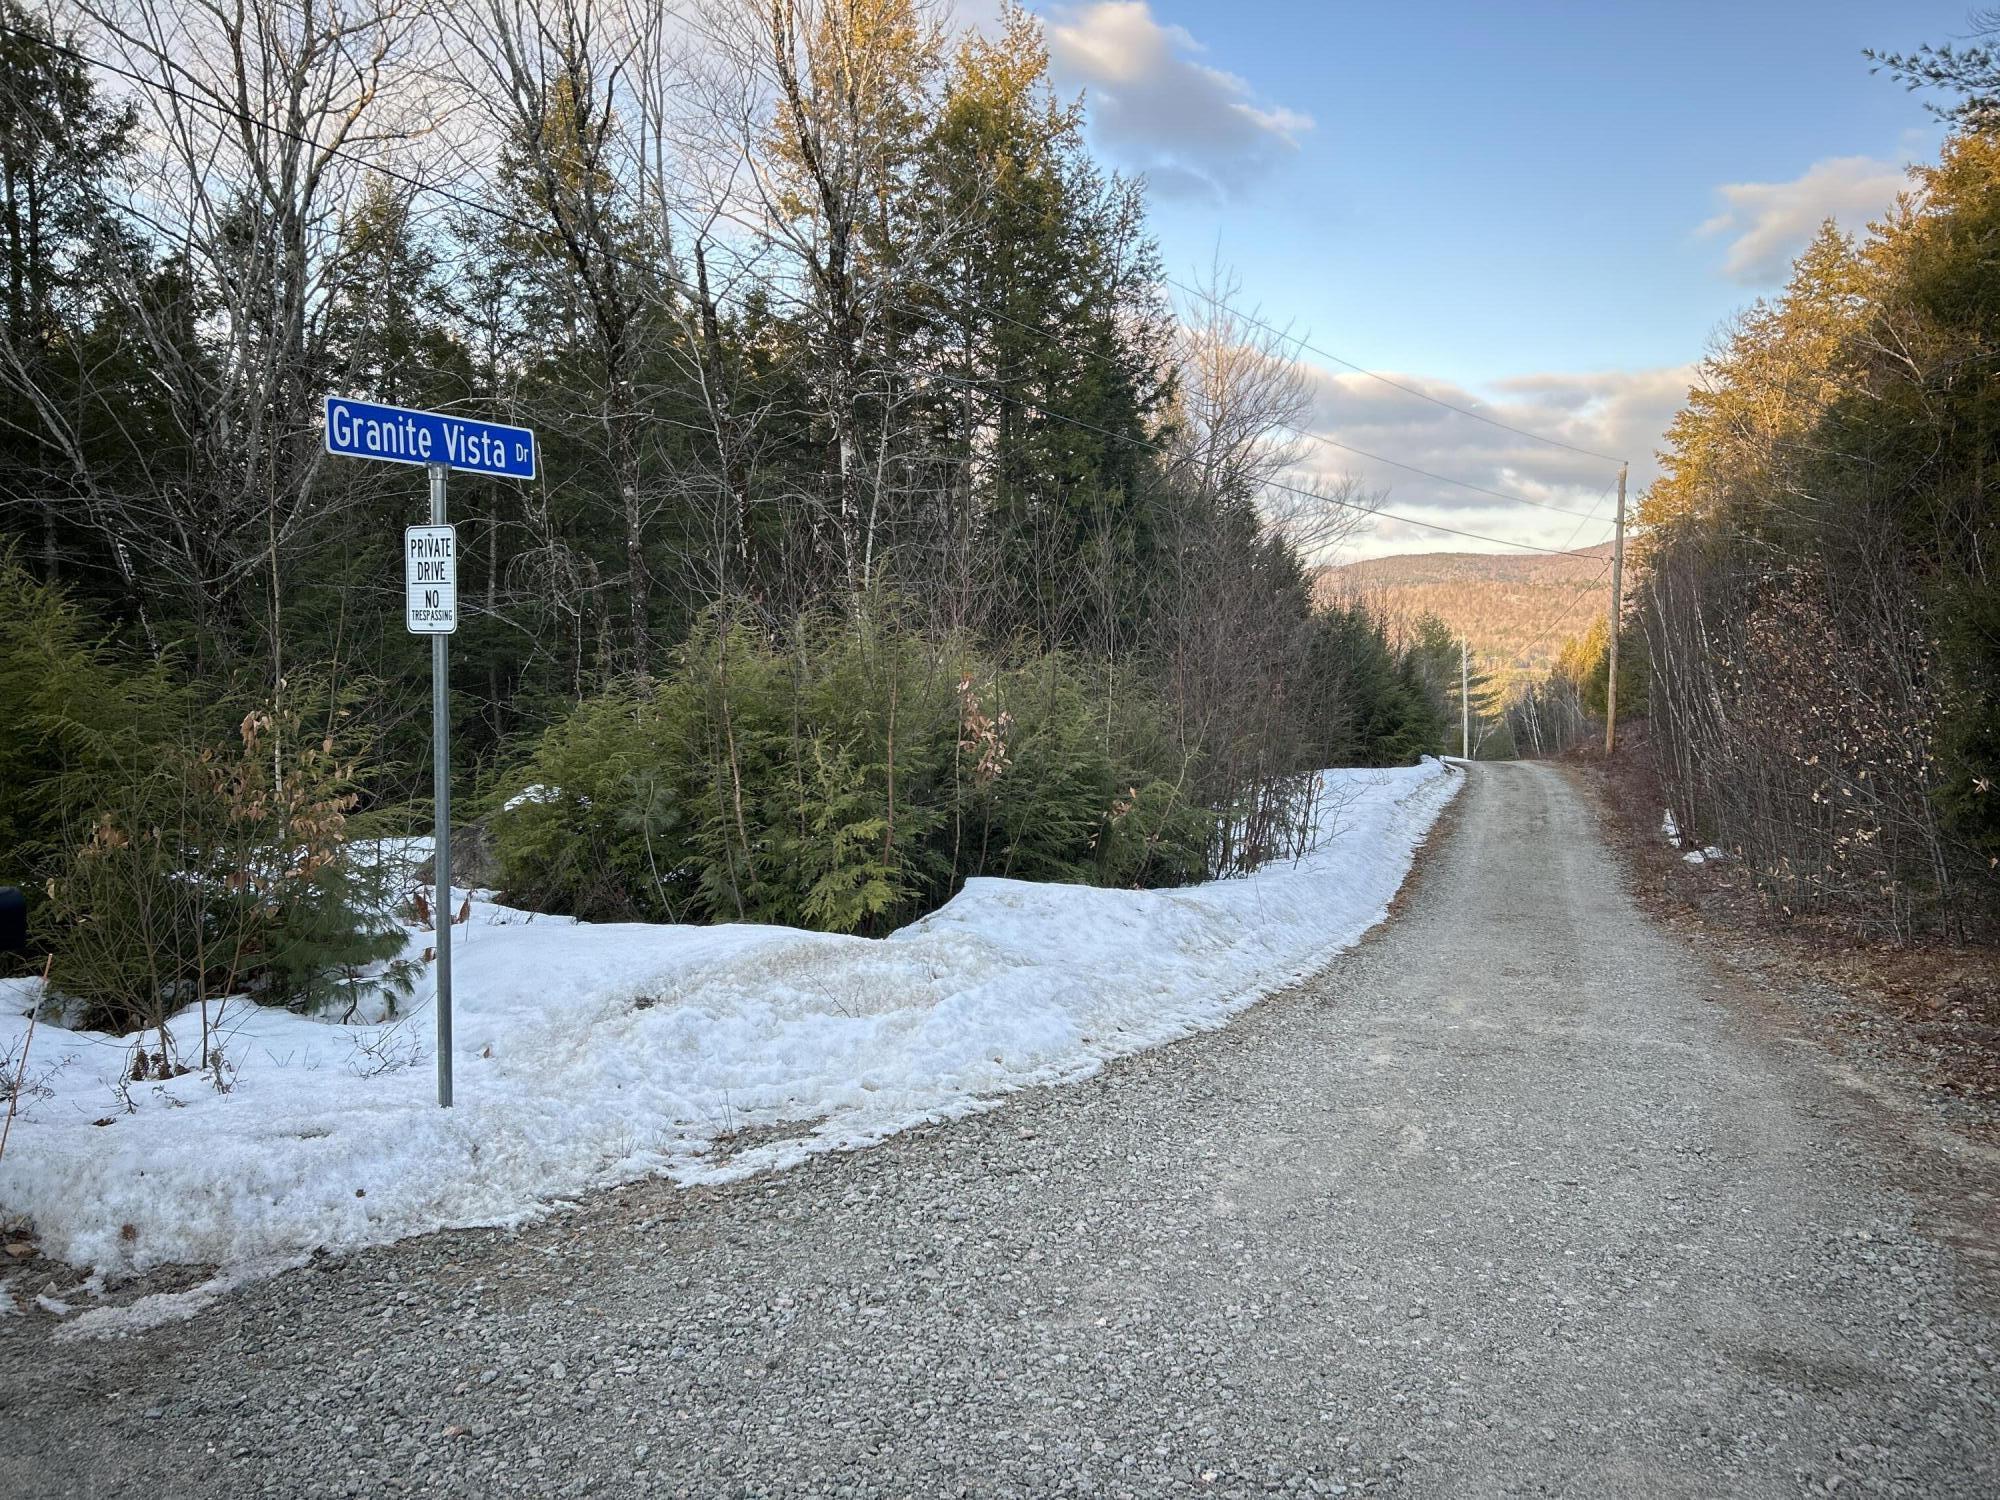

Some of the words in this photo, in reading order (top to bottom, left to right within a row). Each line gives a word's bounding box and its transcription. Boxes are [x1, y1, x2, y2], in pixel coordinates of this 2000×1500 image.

[332, 405, 432, 458] Granite
[442, 423, 506, 468] Vista
[515, 443, 529, 463] Dr
[411, 538, 452, 558] PRIVATE
[417, 561, 446, 581] DRIVE
[425, 589, 440, 608] NO
[411, 609, 453, 621] TRESPASSING
